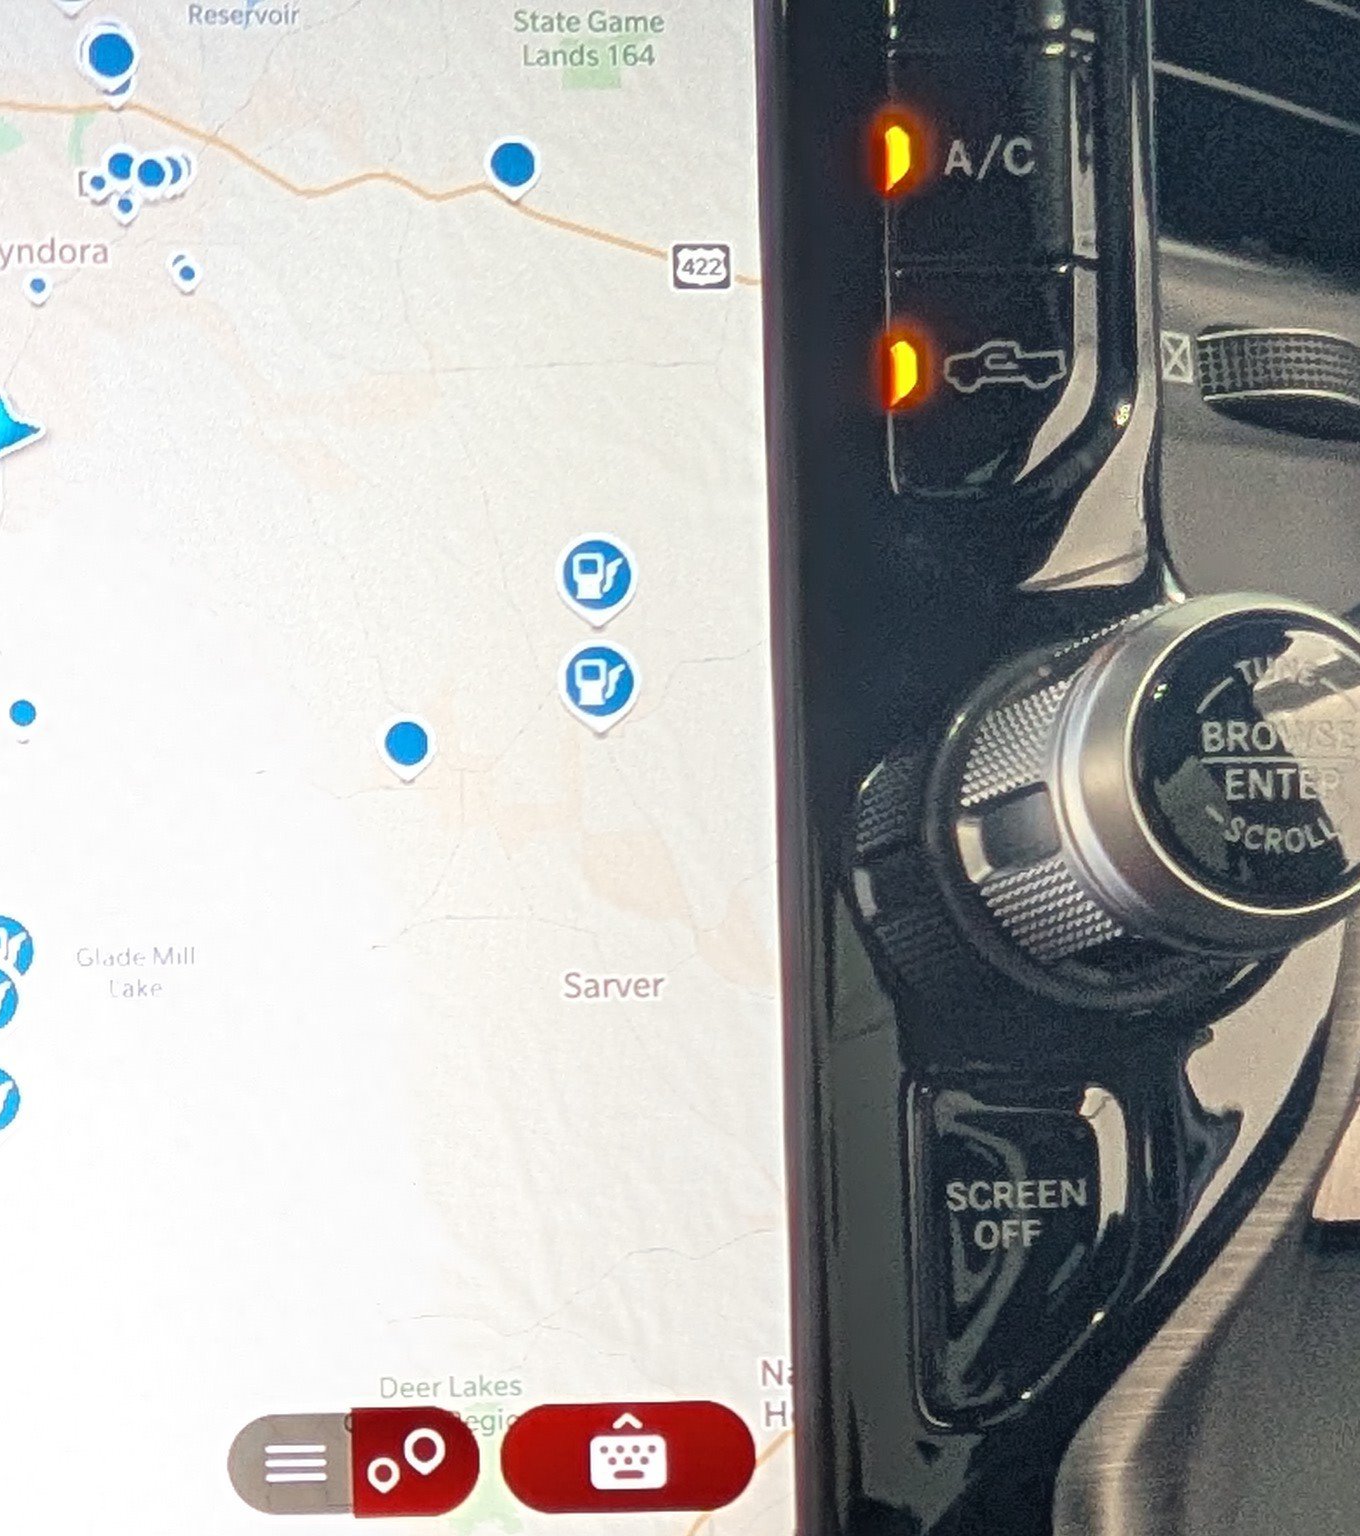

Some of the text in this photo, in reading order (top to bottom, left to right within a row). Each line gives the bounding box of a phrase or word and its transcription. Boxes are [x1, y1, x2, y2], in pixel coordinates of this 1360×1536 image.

[188, 4, 300, 26] Reservoir
[513, 10, 665, 33] State Game
[523, 44, 656, 67] Lands 164
[943, 134, 1036, 180] A/C
[681, 258, 723, 277] 422
[1222, 814, 1342, 854] SCROLL
[76, 946, 196, 967] Glade Mill
[109, 979, 164, 998] Lake
[564, 971, 666, 999] Sarver
[945, 1178, 1088, 1212] SCREEN
[973, 1219, 1043, 1251] OFF
[761, 1358, 794, 1387] N
[379, 1374, 523, 1399] Deer Lakes
[764, 1401, 793, 1428] H
